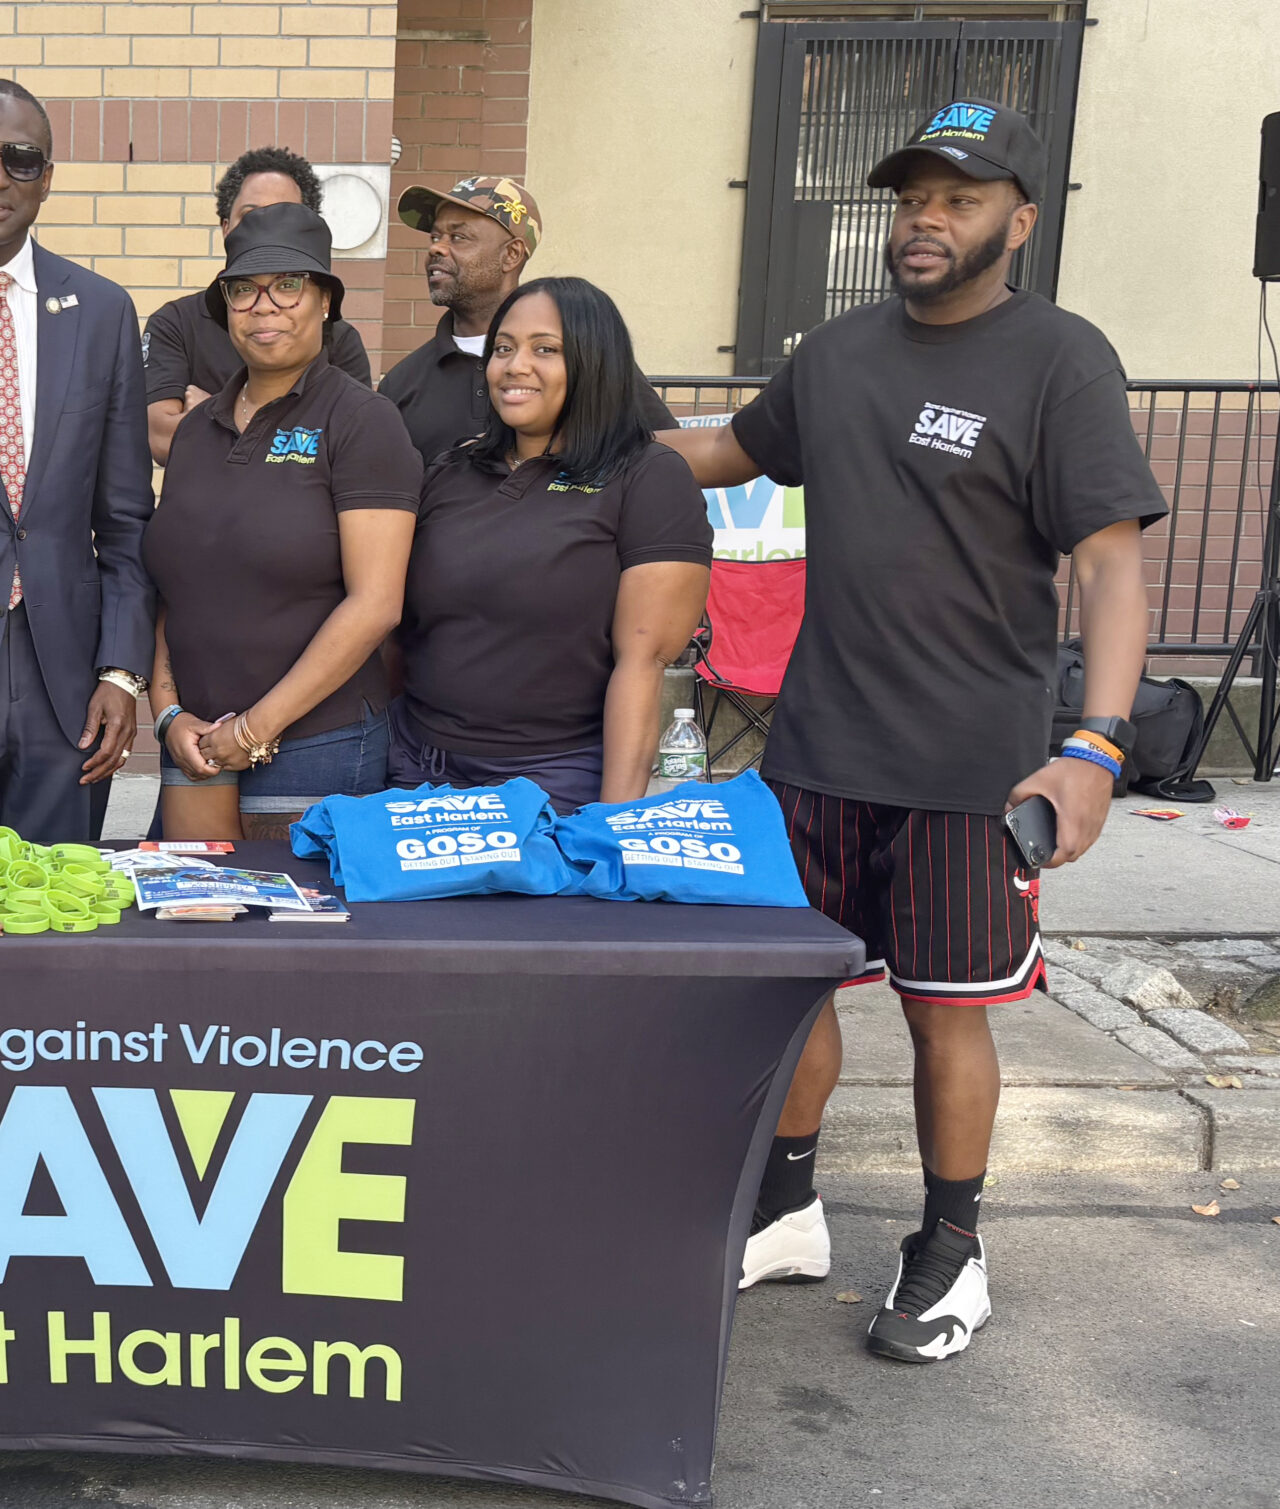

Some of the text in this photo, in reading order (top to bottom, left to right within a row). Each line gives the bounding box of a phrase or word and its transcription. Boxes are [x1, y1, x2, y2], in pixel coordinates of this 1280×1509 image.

[925, 107, 995, 133] SAVE
[942, 129, 984, 141] Harlem
[915, 409, 984, 447] SAVE
[270, 431, 320, 455] SAVE
[909, 432, 972, 458] East Harlem
[265, 453, 286, 464] East
[547, 483, 569, 492] East
[385, 794, 506, 813] SAVE
[605, 802, 730, 825] SAVE
[391, 811, 508, 826] East Harlem
[612, 820, 732, 831] East Harlem
[432, 826, 469, 834] PROGRAM
[396, 831, 517, 860] GOSO
[618, 836, 741, 862] GOSO
[403, 850, 518, 868] GETTING OUT STAYING OUT
[624, 853, 741, 872] GETTING OUT STAYING OUT
[178, 1023, 424, 1073] Violence
[47, 1310, 403, 1402] Harlem
